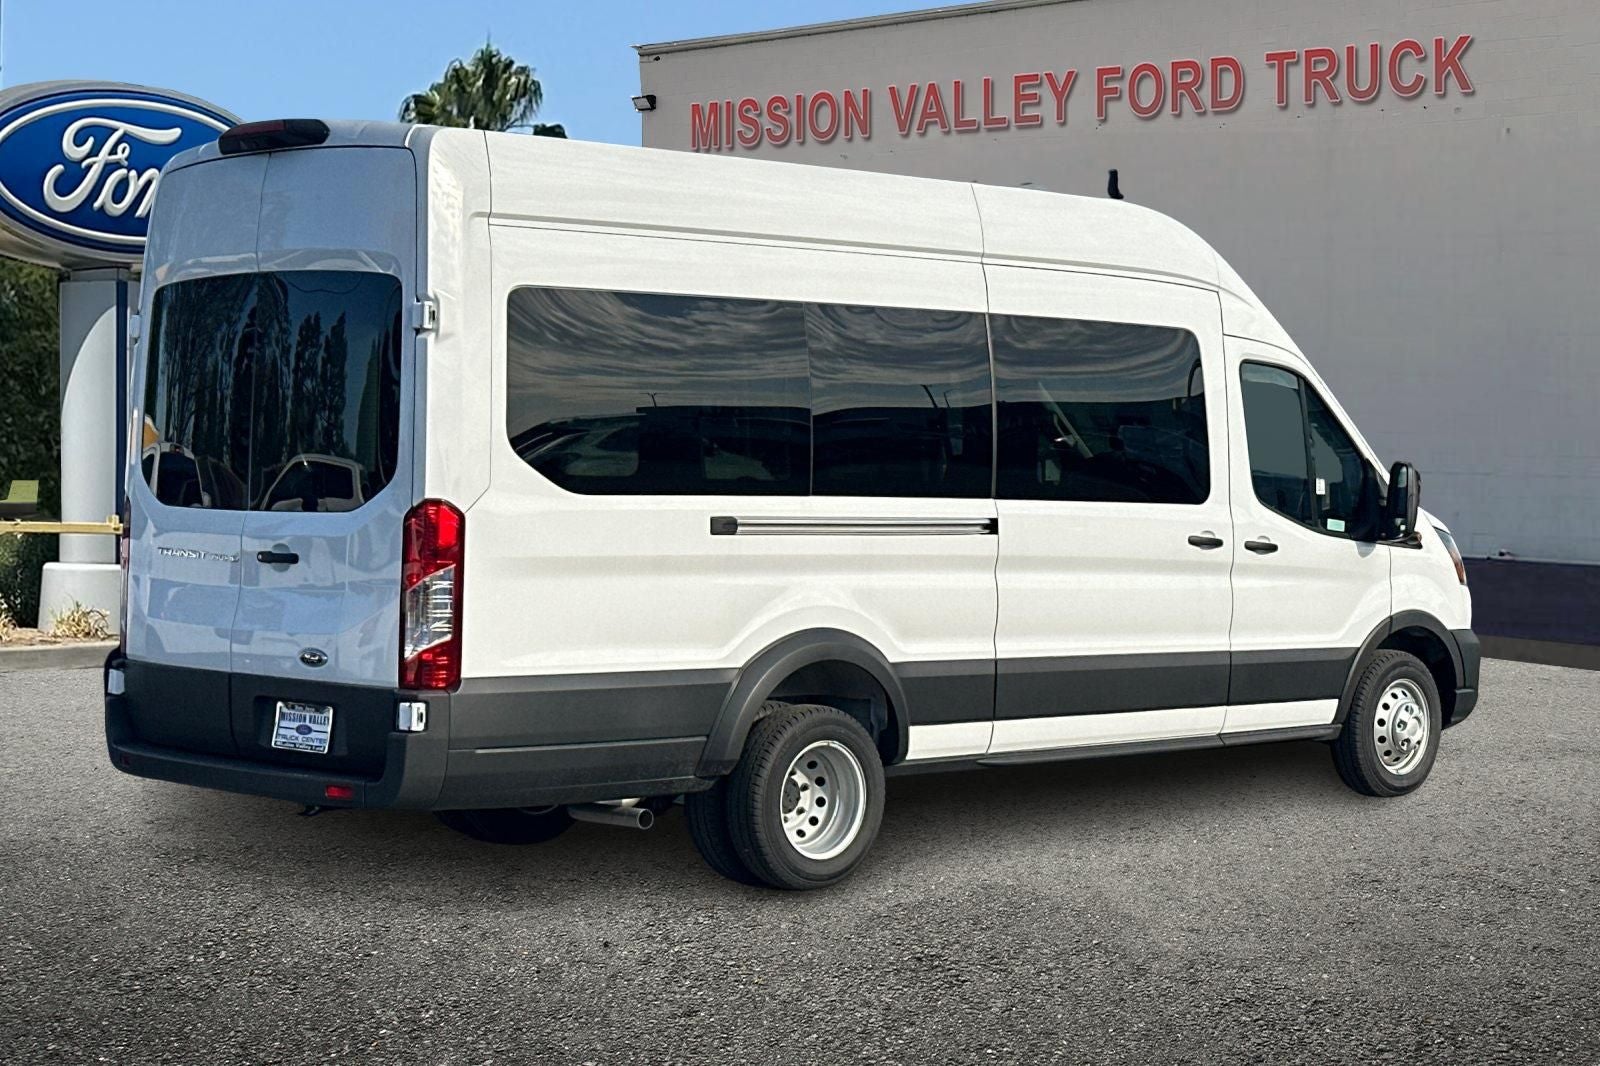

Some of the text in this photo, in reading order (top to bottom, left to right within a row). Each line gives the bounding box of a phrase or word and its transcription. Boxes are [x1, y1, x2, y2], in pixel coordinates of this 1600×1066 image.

[690, 34, 1473, 151] MISSION VALLEY FORD TRUCK
[43, 116, 182, 218] For
[157, 546, 209, 560] TRANSIT
[280, 711, 307, 723] MISSION
[276, 734, 299, 742] TRUCK
